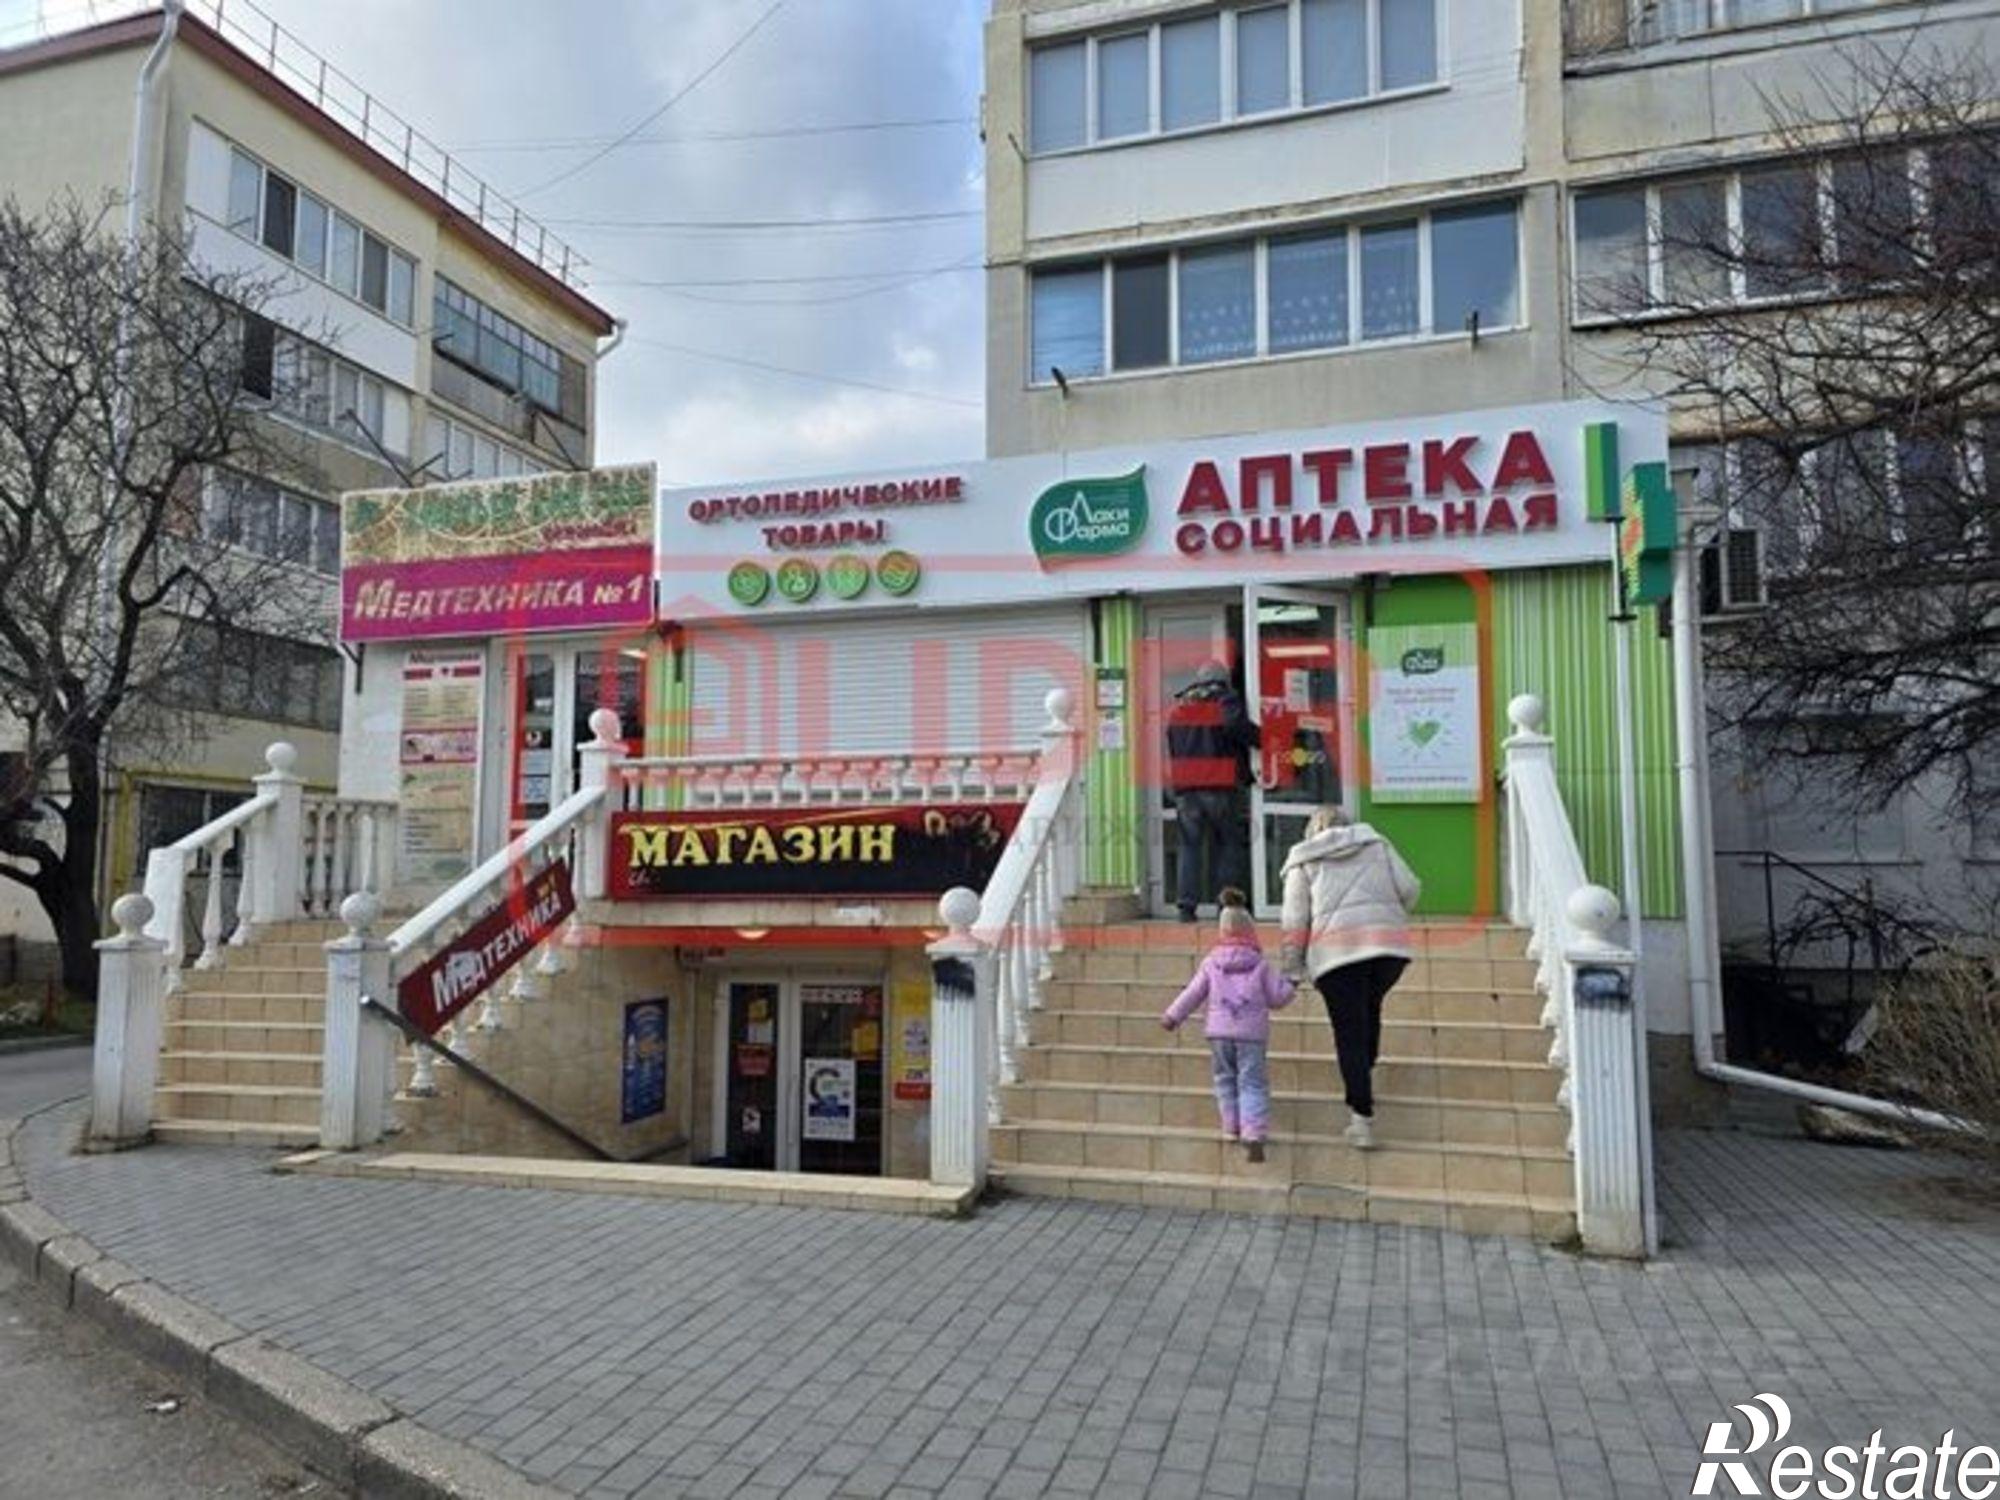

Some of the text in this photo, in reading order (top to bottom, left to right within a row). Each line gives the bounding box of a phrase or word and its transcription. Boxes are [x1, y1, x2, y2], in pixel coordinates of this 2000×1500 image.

[1177, 431, 1556, 515] АПТЕКА
[689, 477, 962, 522] ОРТОПЕДИЧЕСКИЕ
[762, 520, 885, 548] ТОВАРЫ
[1175, 494, 1558, 554] СОЦИАЛЬНАЯ
[628, 823, 897, 868] МАГАЗИН
